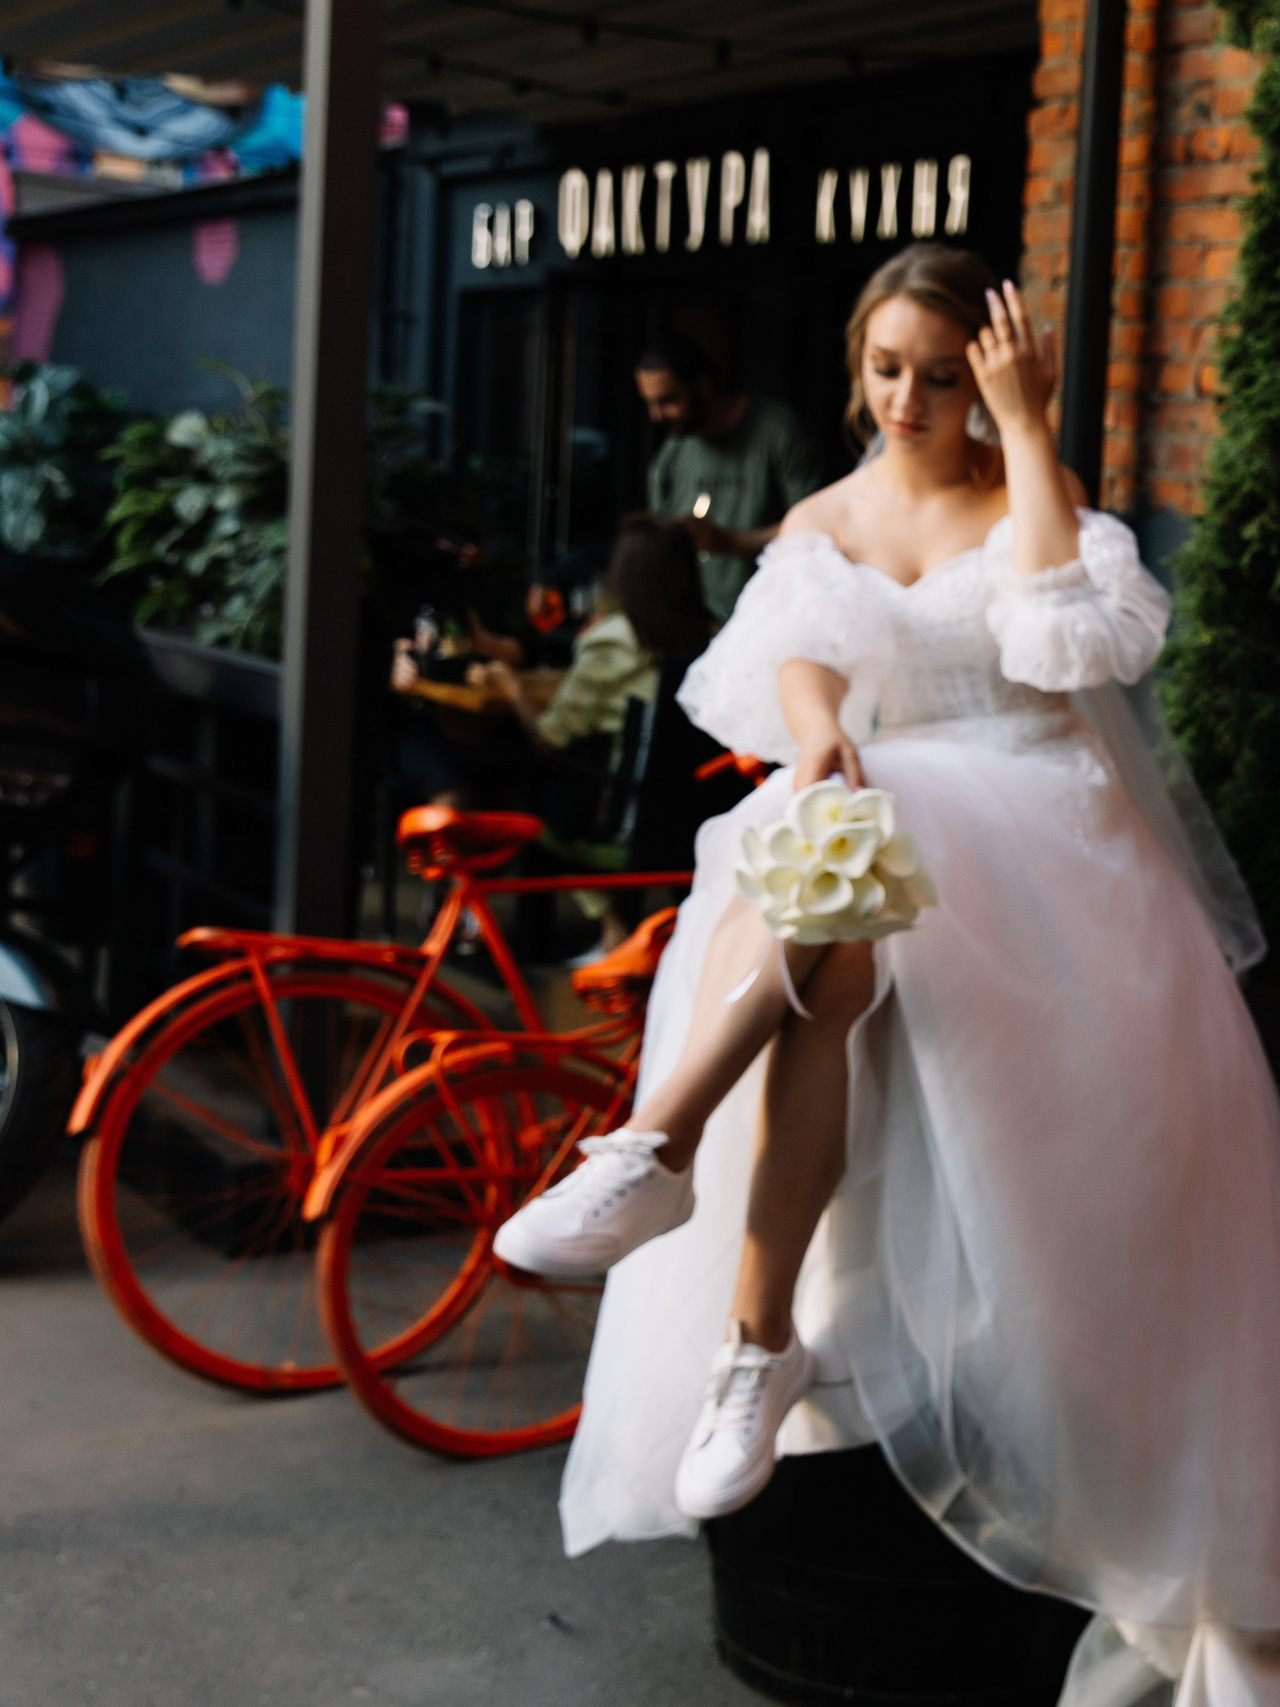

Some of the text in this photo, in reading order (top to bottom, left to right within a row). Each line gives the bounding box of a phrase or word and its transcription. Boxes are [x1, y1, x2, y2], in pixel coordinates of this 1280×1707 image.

[471, 146, 972, 268] БАР ФАКТУРА КУХНЯ
